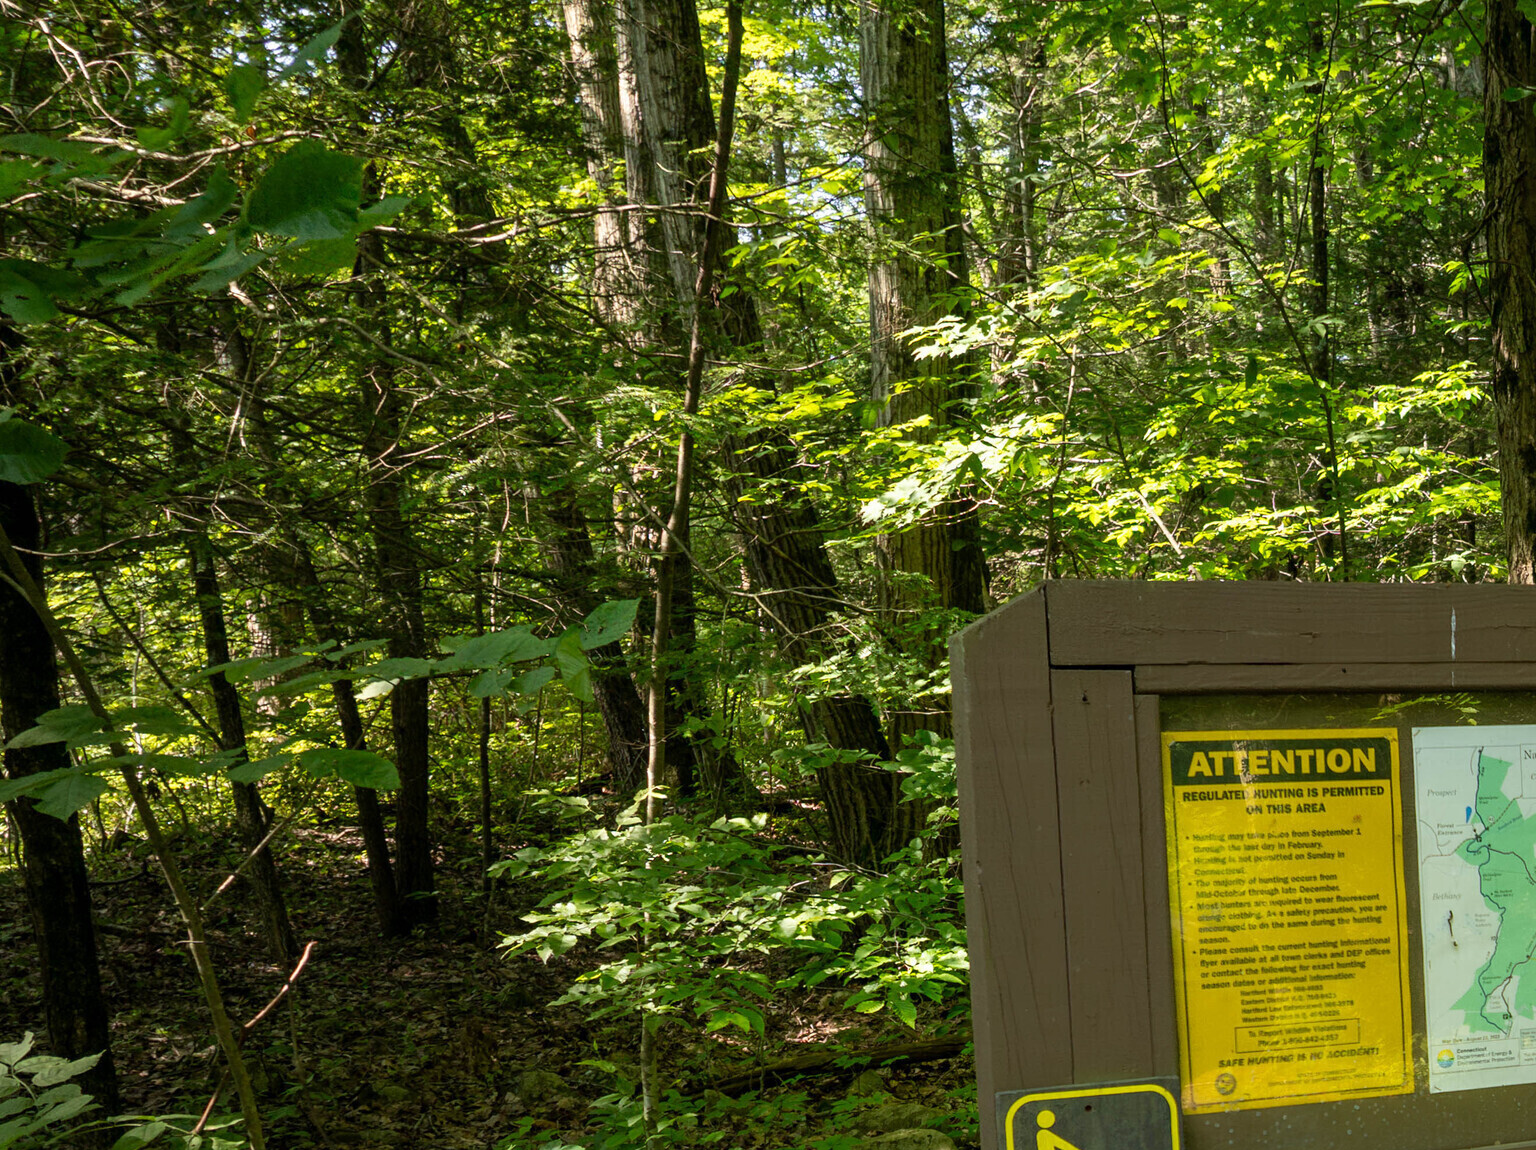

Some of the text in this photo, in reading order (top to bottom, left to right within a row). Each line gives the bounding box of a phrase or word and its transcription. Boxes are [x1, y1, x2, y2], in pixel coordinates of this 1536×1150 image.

[1188, 748, 1376, 777] ATTENTION
[1183, 786, 1384, 802] REGULATED HUNTING IS PERMITTED
[1427, 789, 1456, 798] Prospect
[1246, 803, 1326, 815] ON THIS AREA
[1312, 828, 1354, 838] September
[1356, 828, 1362, 836] 1
[1306, 852, 1335, 860] Sunday
[1213, 878, 1245, 887] majority
[1259, 876, 1289, 884] hunting
[1196, 889, 1245, 898] Mid-October
[1248, 888, 1279, 896] through
[1282, 886, 1296, 894] late
[1433, 892, 1462, 901] Bethany
[1197, 902, 1218, 910] Most
[1269, 898, 1302, 906] required
[1336, 893, 1379, 902] fluorescent
[1286, 908, 1310, 917] safety
[1313, 906, 1356, 916] precaution,
[1359, 906, 1373, 914] you
[1198, 923, 1246, 933] encouraged
[1311, 918, 1335, 927] during
[1352, 915, 1382, 924] hunting
[1200, 948, 1227, 956] Please
[1230, 945, 1259, 953] consult
[1278, 942, 1306, 950] current
[1308, 941, 1338, 950] hunting
[1340, 936, 1390, 946] informational
[1200, 959, 1218, 968] flyer
[1221, 956, 1256, 965] available
[1270, 954, 1279, 962] all
[1304, 952, 1327, 960] clerks
[1365, 948, 1391, 956] offices
[1211, 969, 1243, 977] contact
[1261, 966, 1297, 974] following
[1336, 961, 1366, 970] hunting
[1201, 982, 1230, 990] season
[1258, 1024, 1347, 1037] Report Violations
[1219, 1047, 1379, 1068] SAFE HUNTING IS NO ACCIDENT!
